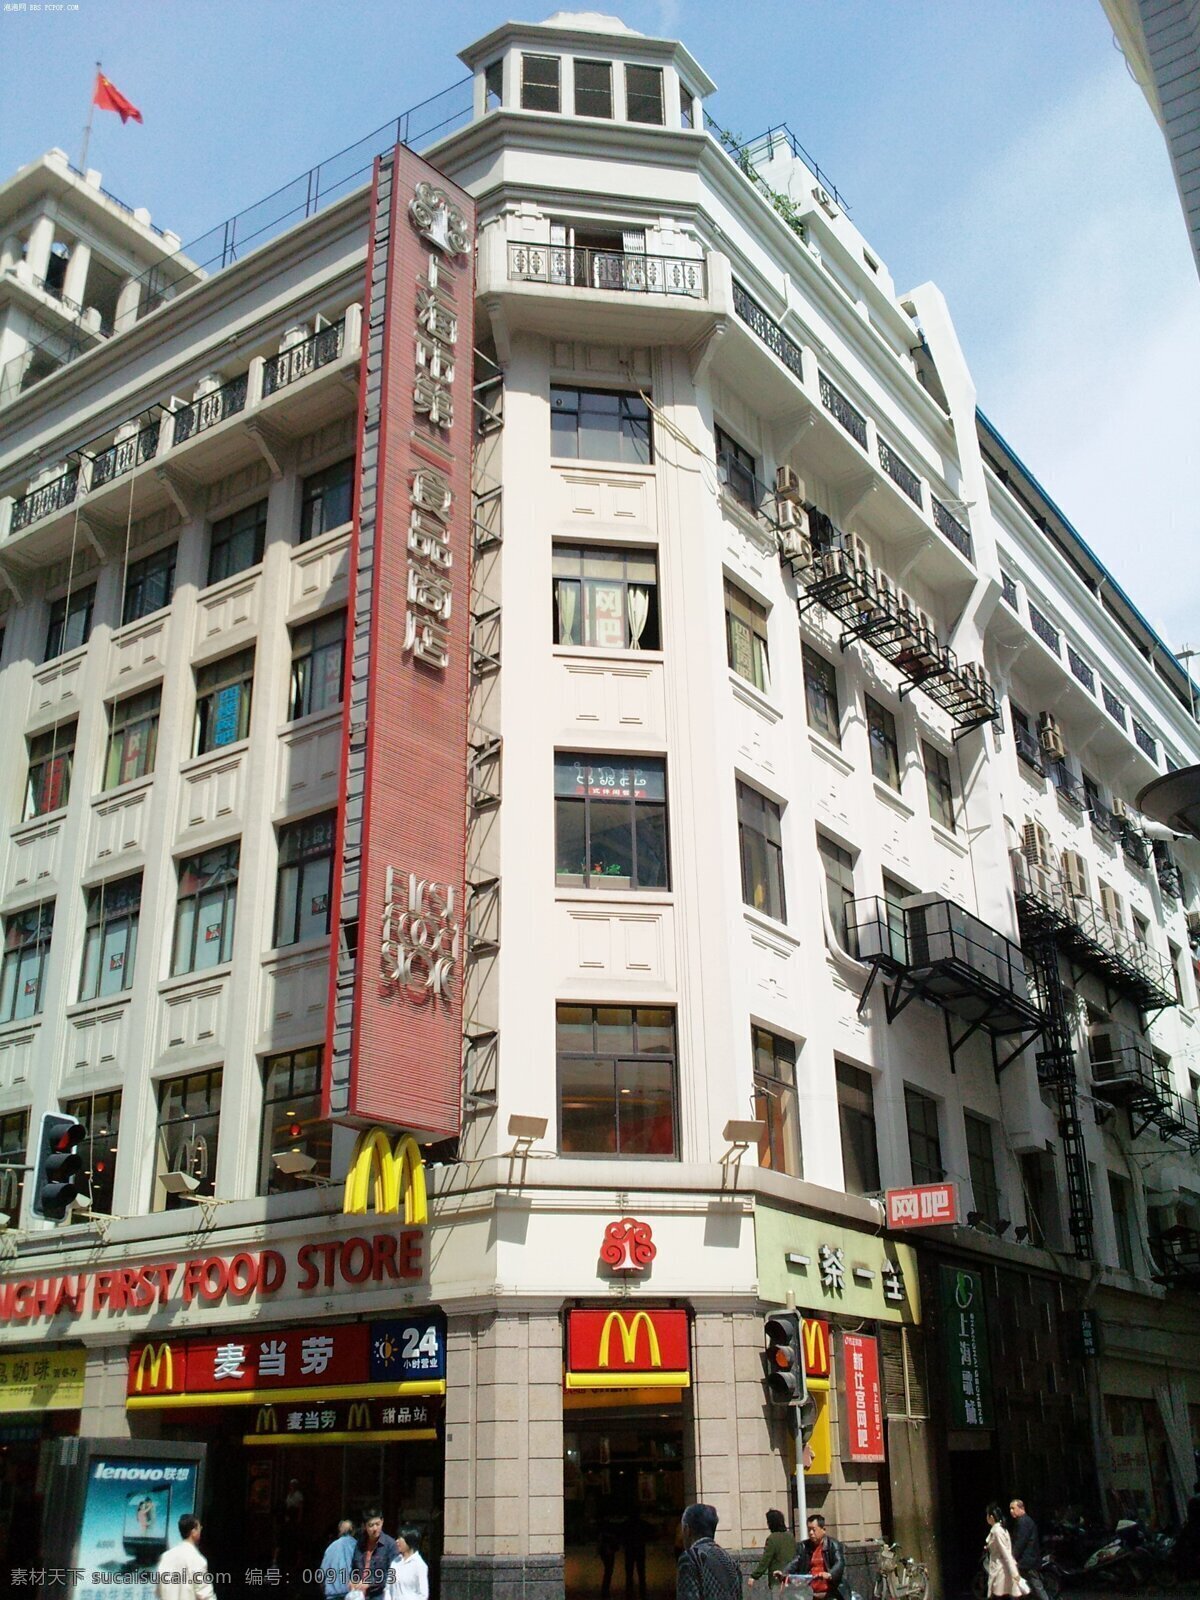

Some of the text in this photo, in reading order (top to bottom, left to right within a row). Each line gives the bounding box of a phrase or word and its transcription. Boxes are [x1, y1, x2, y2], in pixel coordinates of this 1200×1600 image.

[891, 1190, 950, 1222] 网吧
[92, 1262, 178, 1312] FIRST
[181, 1249, 286, 1304] FOOD
[297, 1229, 423, 1291] STORE
[402, 1325, 439, 1359] 24
[213, 1336, 334, 1381] 麦当劳
[403, 1358, 439, 1370] 小时营业
[287, 1410, 337, 1431] 麦当劳
[382, 1406, 428, 1425] 甜品站
